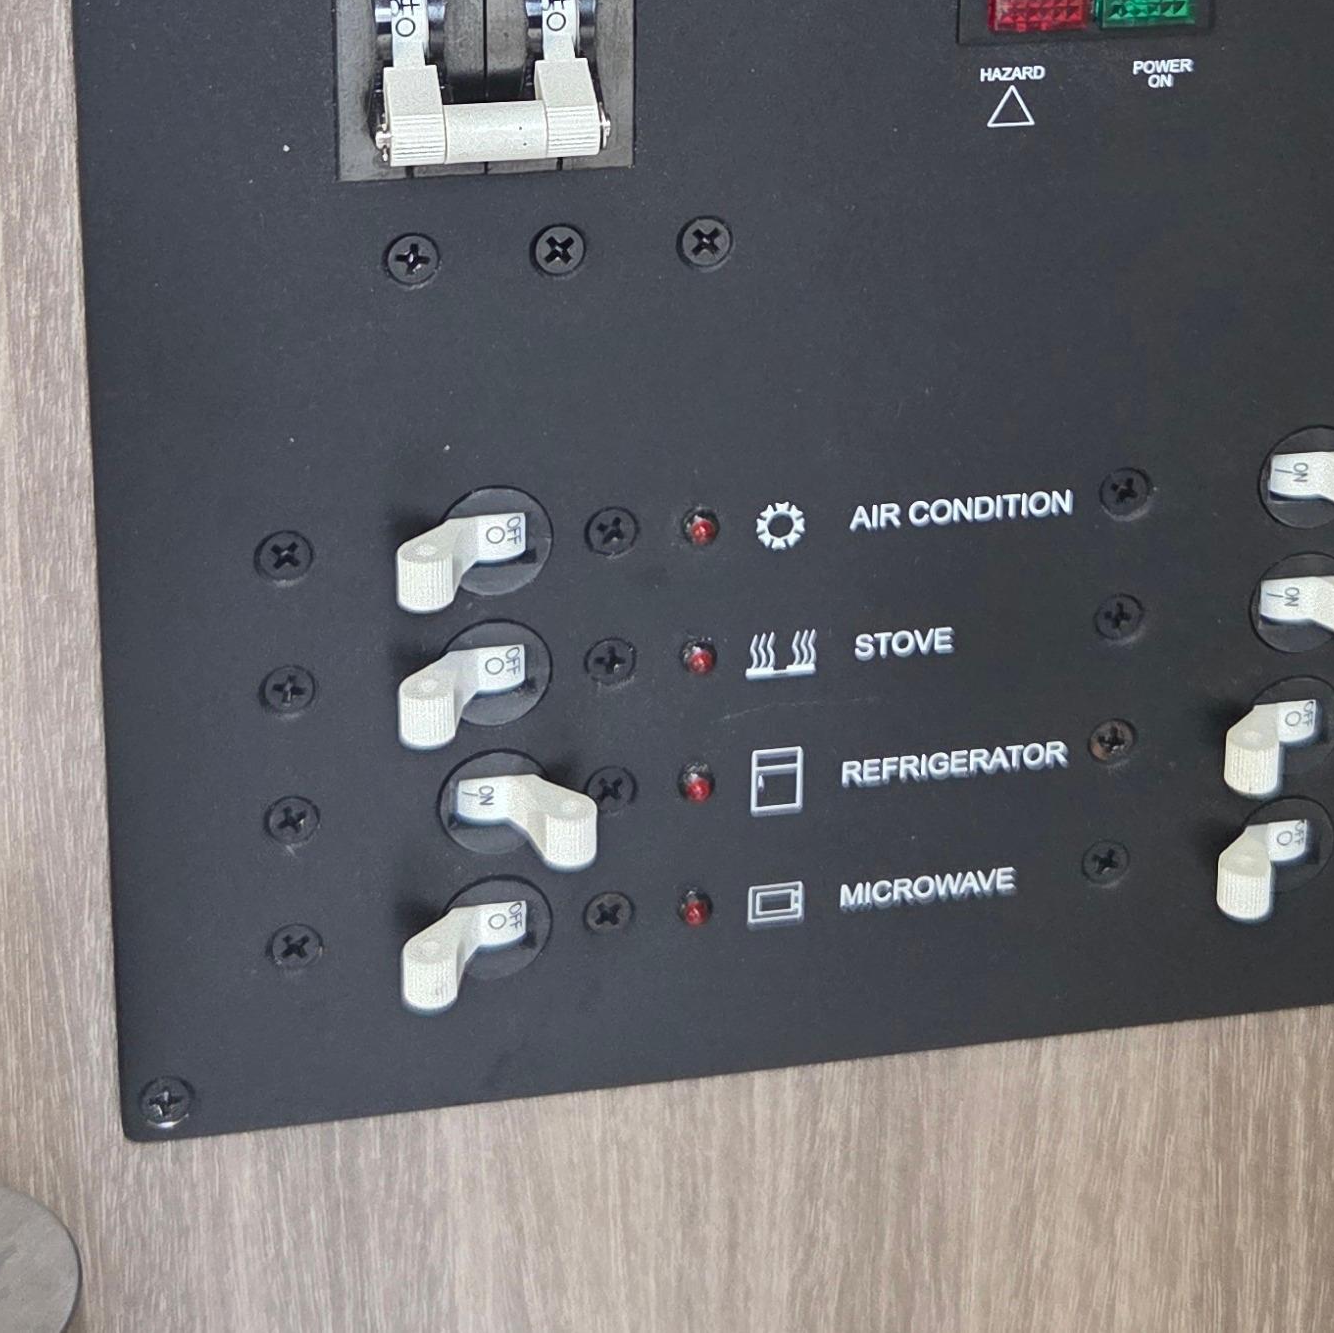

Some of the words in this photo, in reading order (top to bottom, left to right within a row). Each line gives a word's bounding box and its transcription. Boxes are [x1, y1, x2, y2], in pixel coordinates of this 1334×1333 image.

[980, 66, 1045, 82] HAZARD
[1133, 58, 1193, 74] POWER
[1148, 74, 1174, 88] ON
[1293, 462, 1308, 483] ON
[850, 504, 901, 532] AIR
[908, 489, 1074, 527] CONDITION
[507, 516, 521, 545] OFF
[1284, 587, 1300, 607] ON
[854, 627, 954, 660] STOVE
[506, 647, 520, 675] OFF
[841, 741, 1067, 787] REFRIGERATOR
[478, 785, 494, 806] ON
[840, 866, 1017, 911] MICROWAVE
[508, 902, 522, 929] OFF
